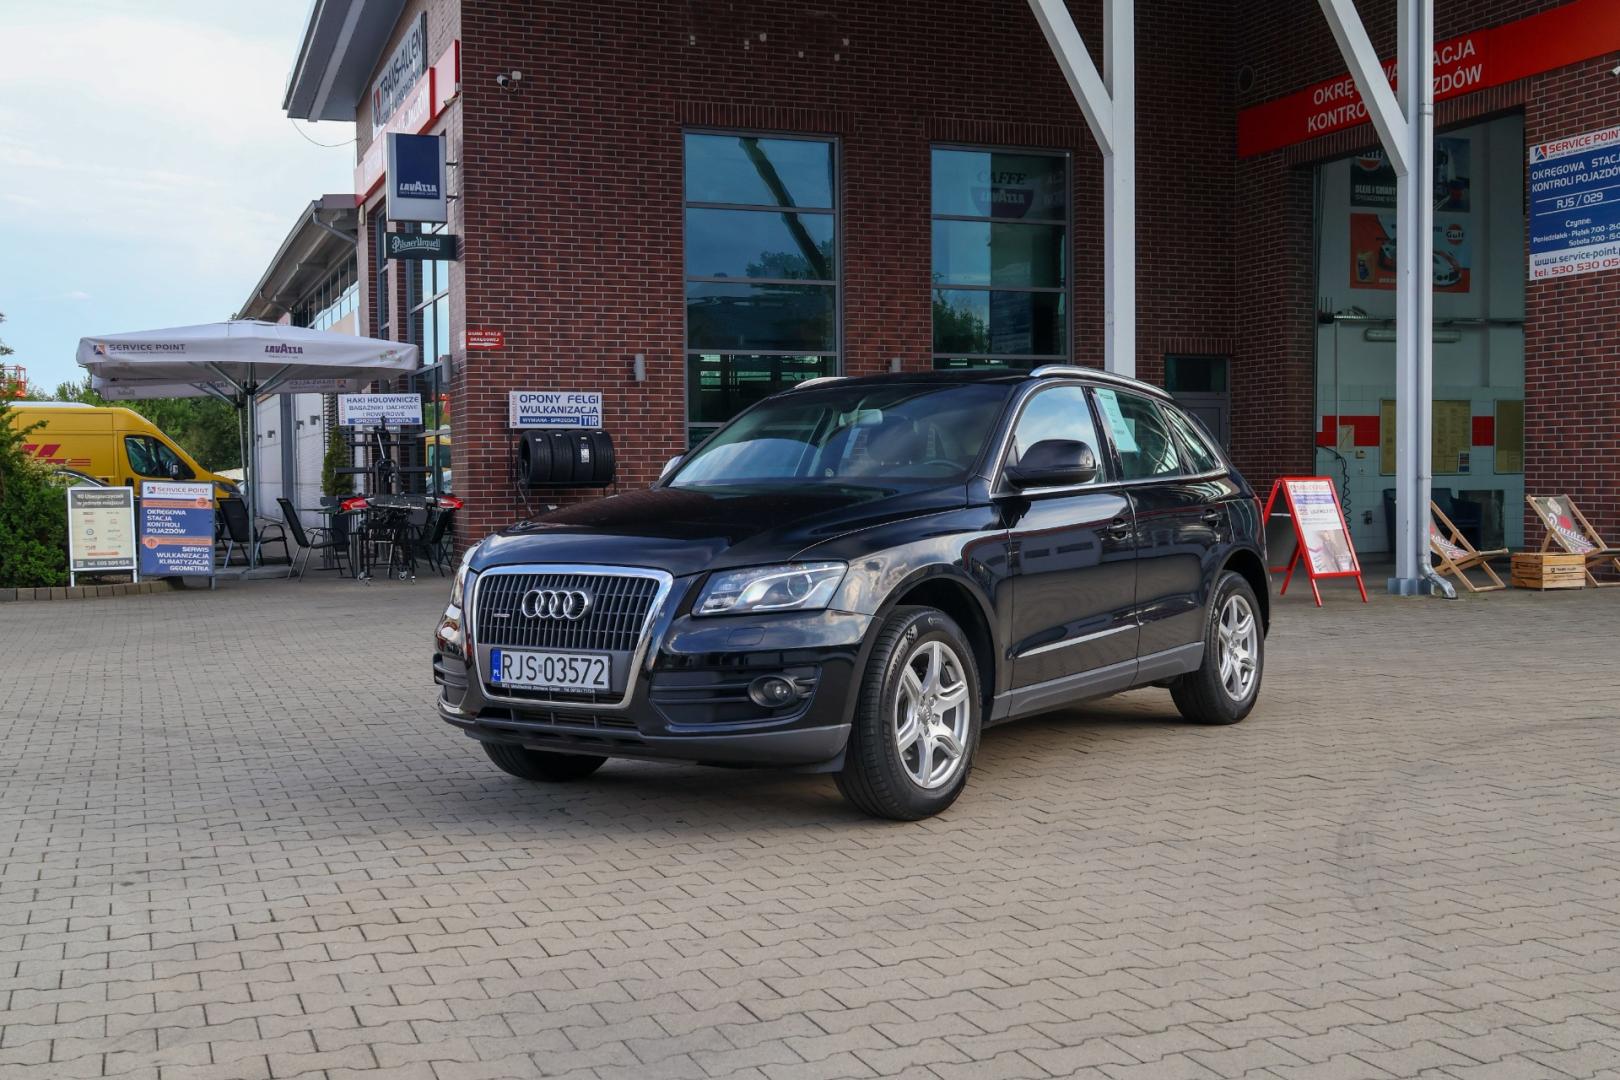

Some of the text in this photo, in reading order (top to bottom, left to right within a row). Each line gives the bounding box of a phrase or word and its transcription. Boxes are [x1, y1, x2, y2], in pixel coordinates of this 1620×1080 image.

[1433, 39, 1476, 67] ACJA
[1548, 135, 1591, 154] SERVICE
[1531, 161, 1585, 181] OKRĘGOWA
[1531, 175, 1574, 193] KONTROLI
[1556, 196, 1575, 210] RJS
[1583, 191, 1604, 205] 029
[391, 235, 416, 254] Pilsner
[1534, 244, 1620, 267] www.service-point.
[1551, 264, 1574, 275] 530
[1576, 260, 1600, 272] 530
[109, 343, 186, 351] SERVICE POINT
[346, 395, 419, 404] HAKI HOLOWNICZE
[519, 394, 599, 403] OPONY FELGI
[519, 405, 598, 414] WULKANIZACJA
[582, 415, 598, 426] TIR
[493, 669, 500, 677] PL
[502, 653, 605, 686] RJS 03572
